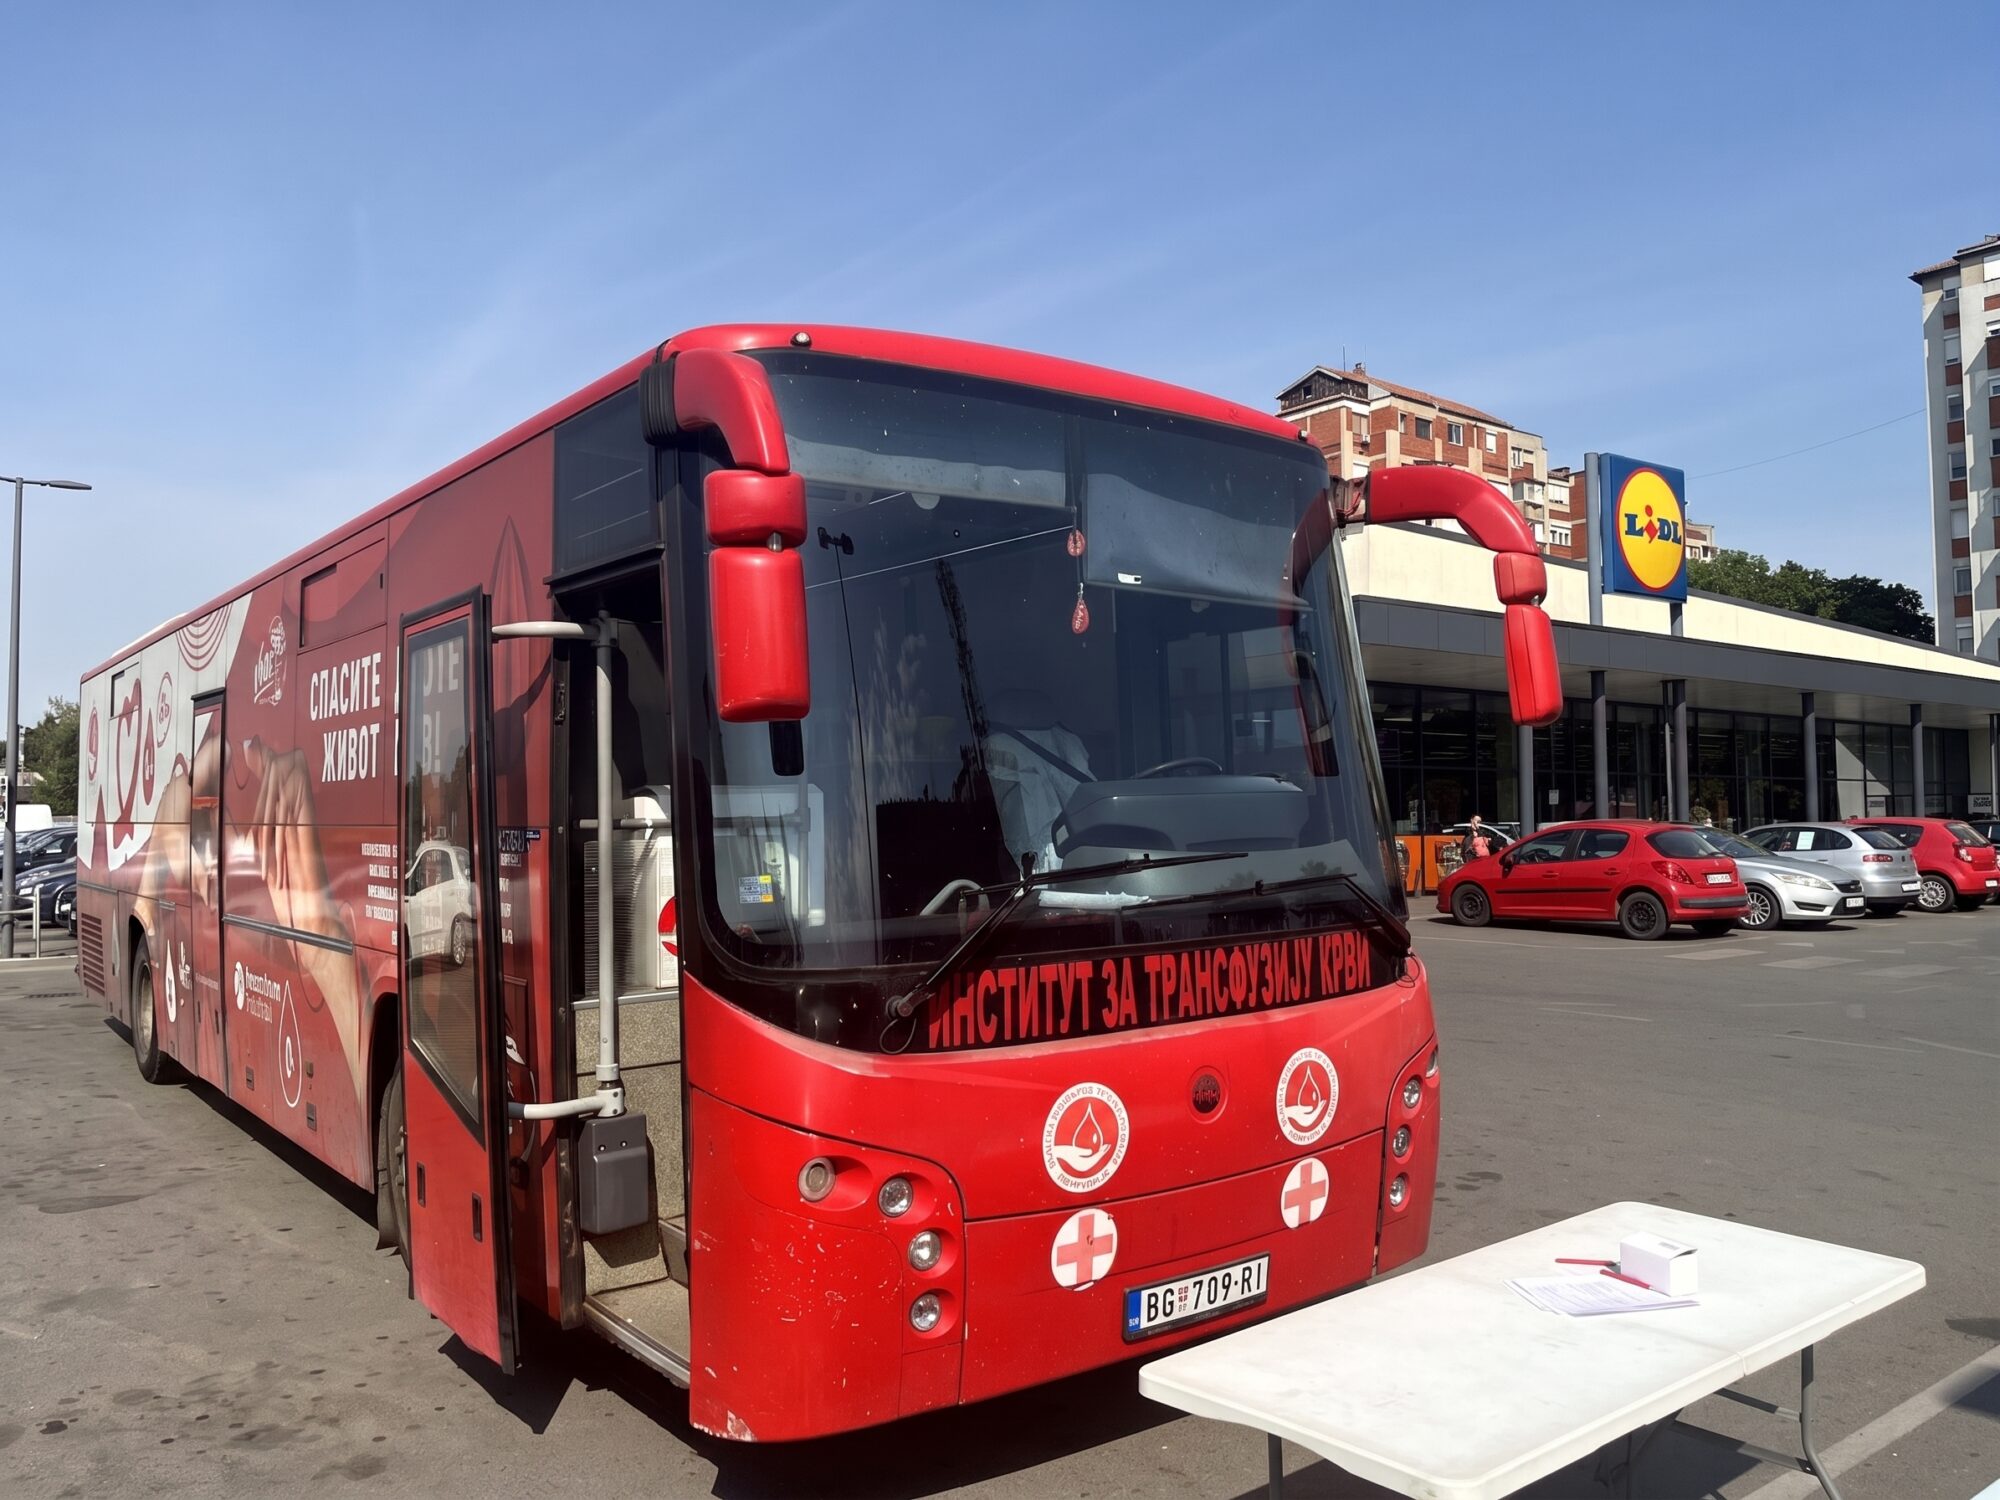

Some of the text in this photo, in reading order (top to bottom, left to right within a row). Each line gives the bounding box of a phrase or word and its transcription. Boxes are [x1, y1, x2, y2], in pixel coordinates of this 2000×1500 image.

[310, 652, 381, 721] СПАСИТЕ
[322, 723, 380, 782] ЖИВОТ
[929, 929, 1371, 1049] ИНСТИТУТ ЗА ТРАНСФУЗИЈУ КРВИ
[1147, 1288, 1174, 1323] BG
